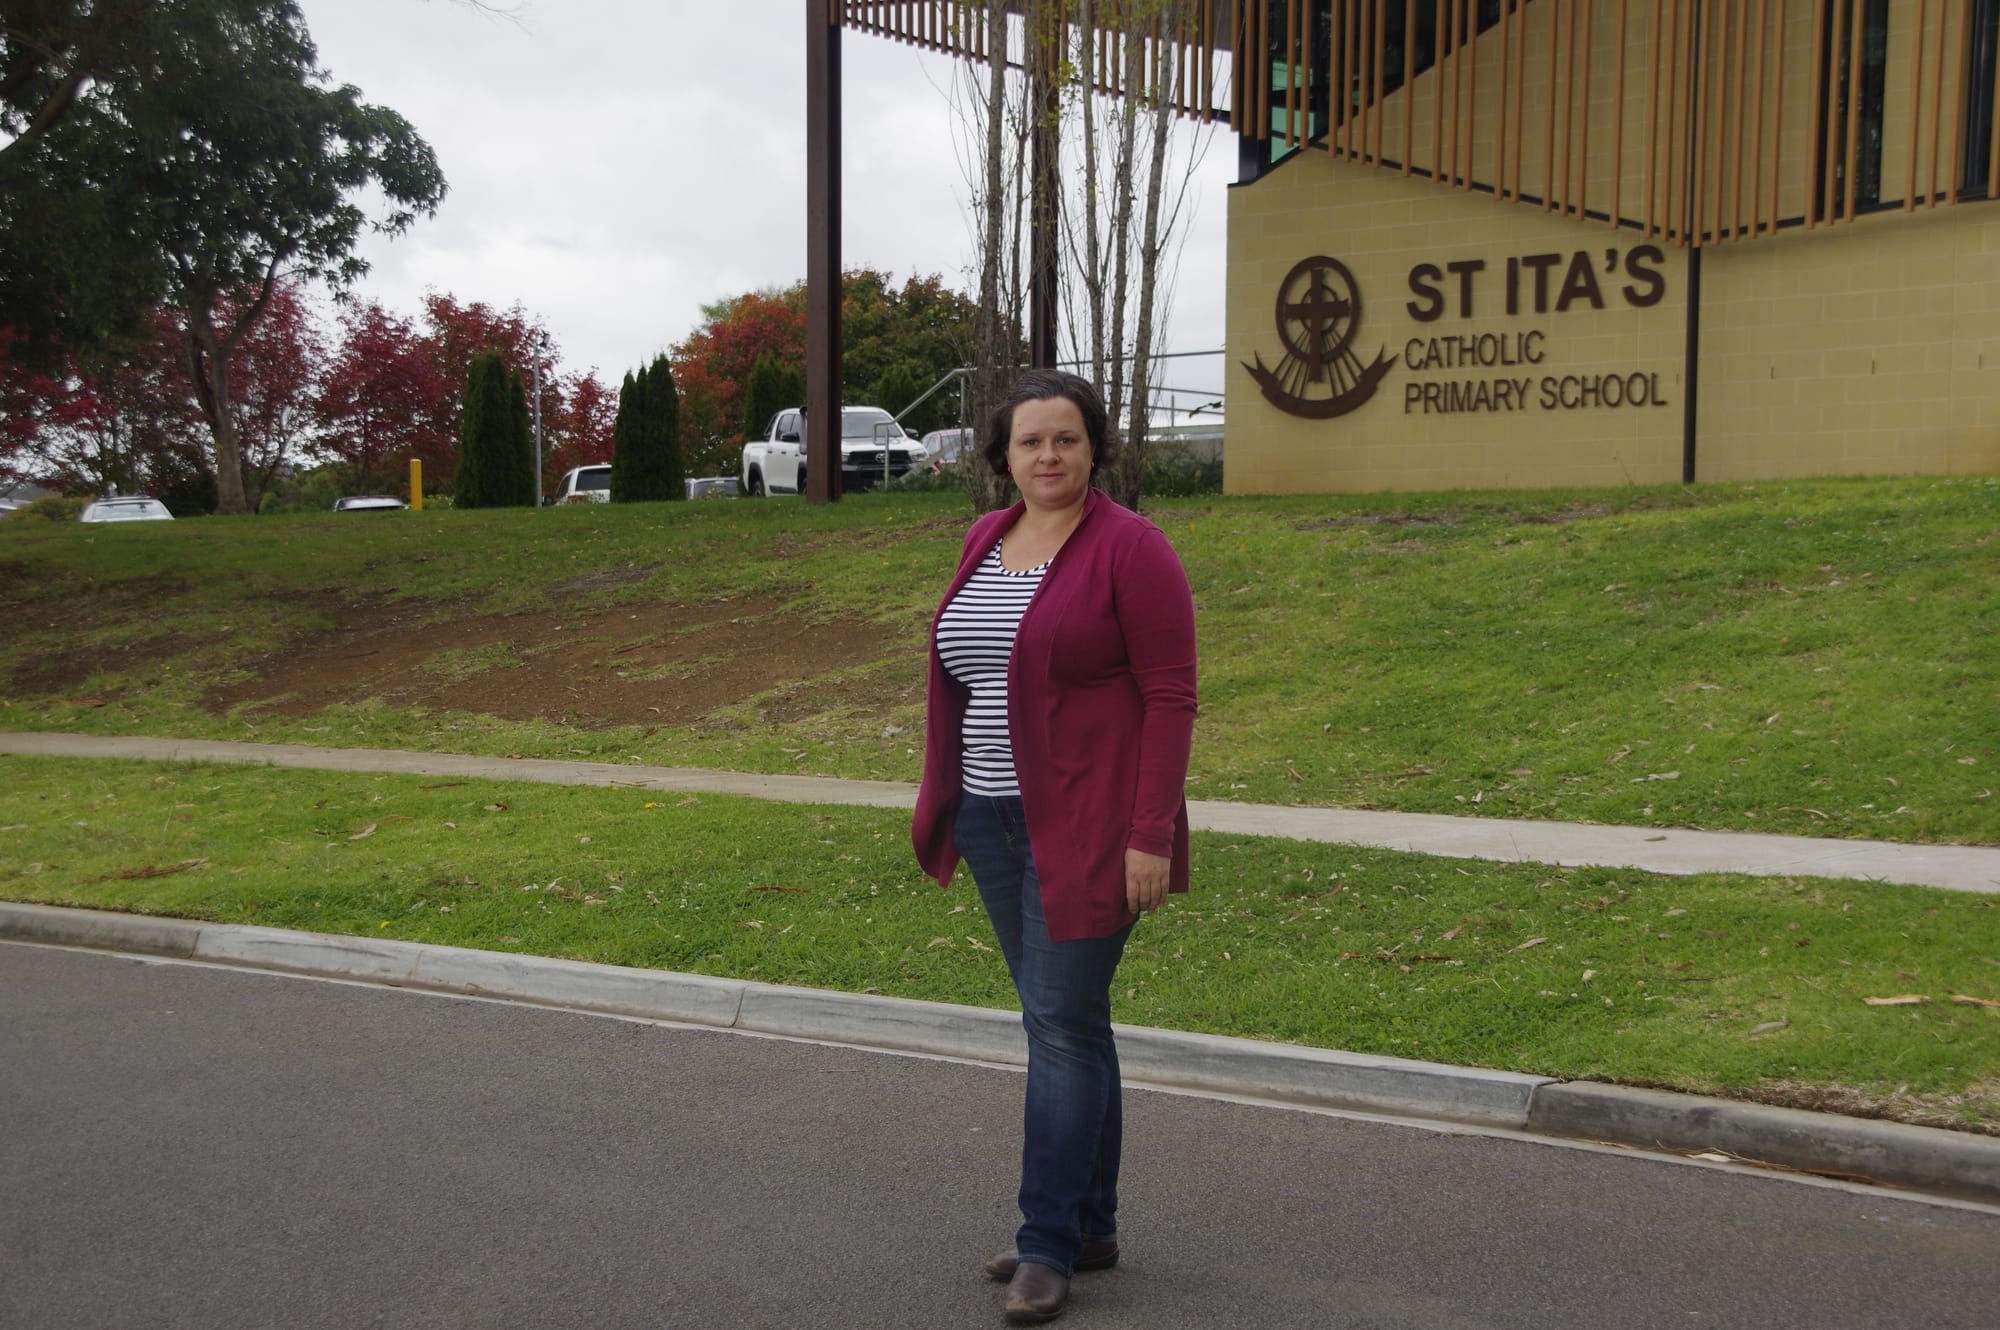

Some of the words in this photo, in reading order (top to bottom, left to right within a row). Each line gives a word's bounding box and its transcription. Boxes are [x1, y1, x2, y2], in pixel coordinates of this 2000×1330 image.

[1406, 259, 1485, 322] ST
[1506, 245, 1666, 315] ITA'S
[1404, 330, 1545, 370] CATHOLIC
[1404, 377, 1532, 414] PRIMARY
[1539, 372, 1667, 410] SCHOOL
